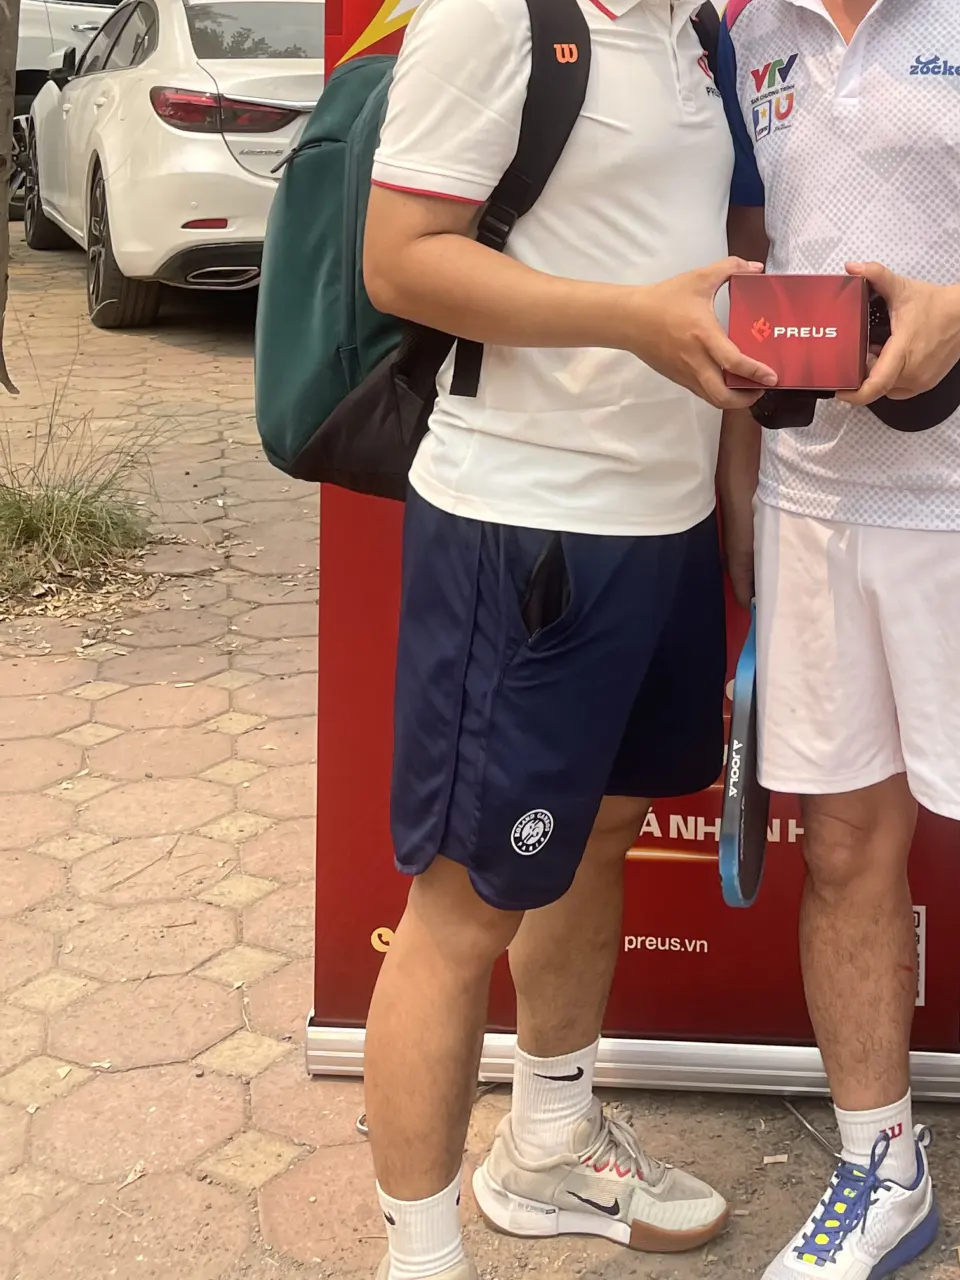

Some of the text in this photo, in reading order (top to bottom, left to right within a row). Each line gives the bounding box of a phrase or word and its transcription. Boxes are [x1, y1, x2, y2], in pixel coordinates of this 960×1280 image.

[750, 52, 799, 93] VTV
[773, 326, 838, 338] PREUS
[728, 752, 742, 797] JOOLA
[669, 814, 781, 843] NHN
[624, 935, 709, 953] preus.vn
